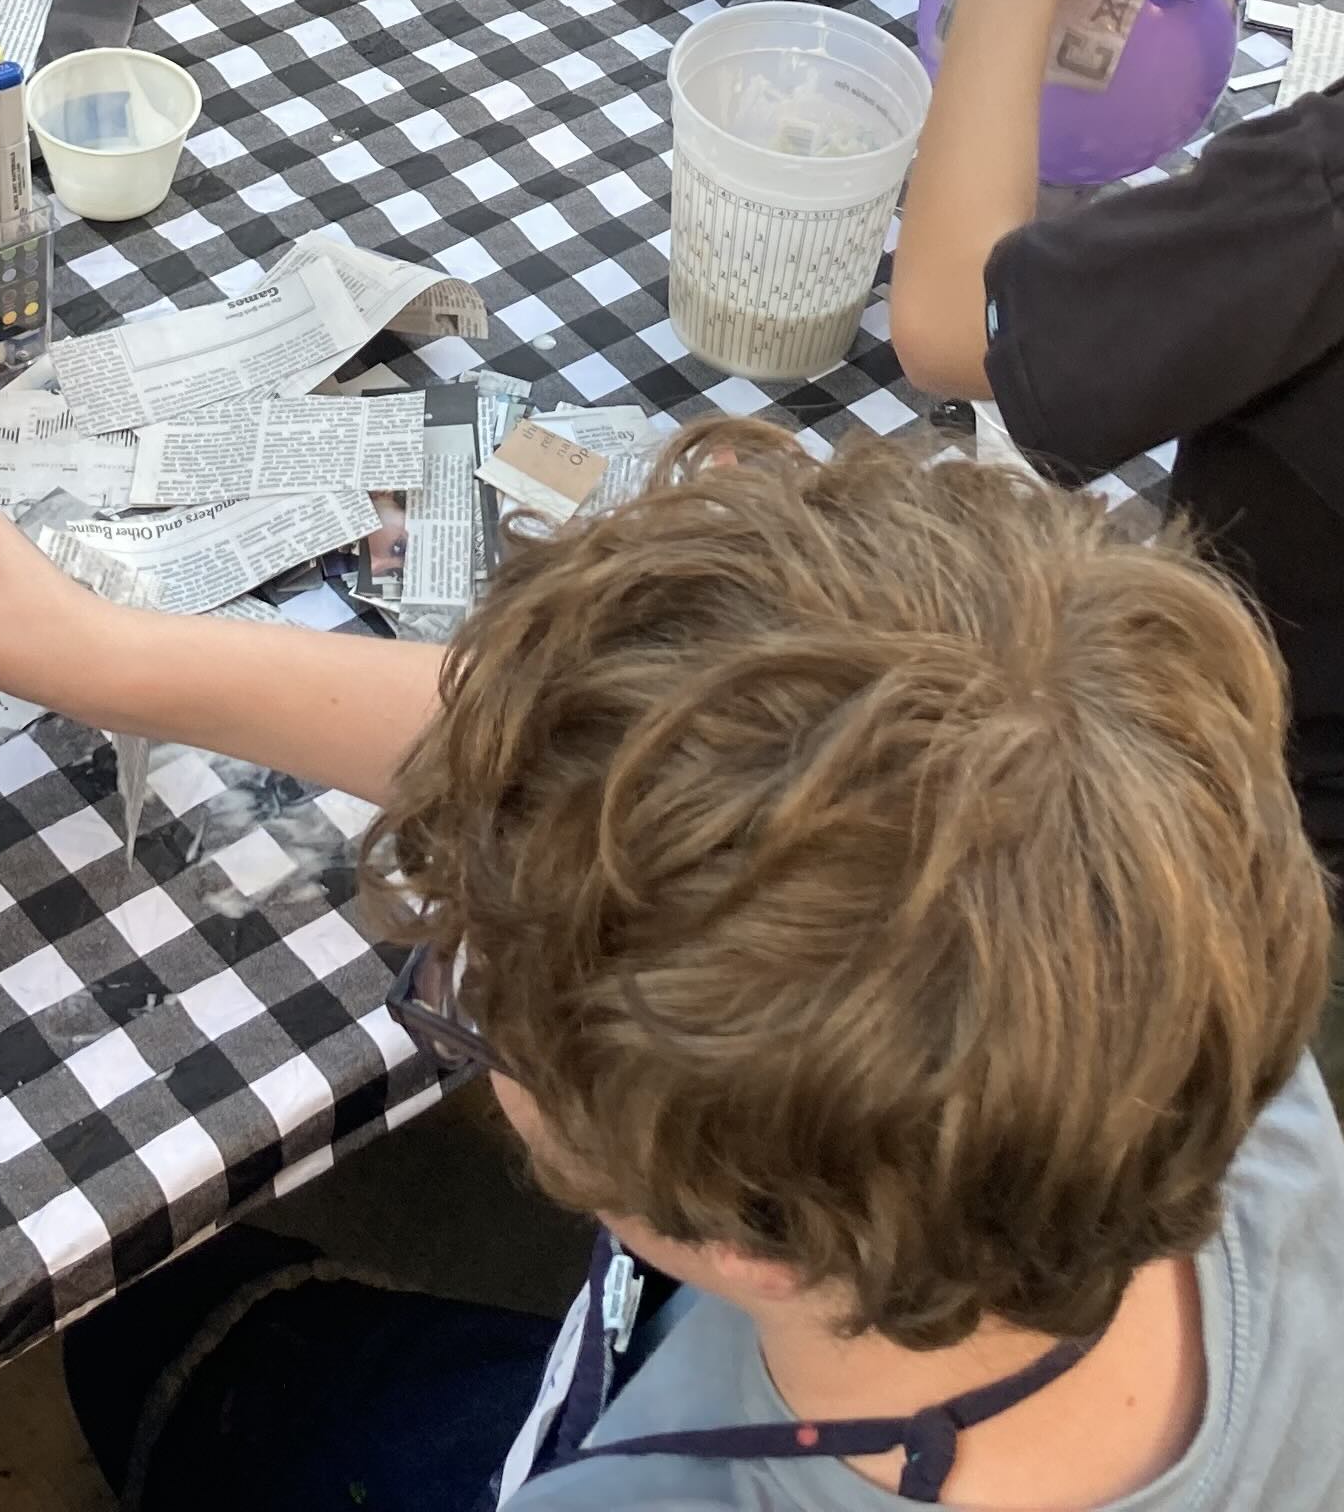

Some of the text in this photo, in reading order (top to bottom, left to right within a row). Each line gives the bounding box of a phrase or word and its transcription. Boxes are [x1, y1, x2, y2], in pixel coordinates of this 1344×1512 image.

[227, 286, 280, 309] Games
[116, 526, 153, 540] Other
[155, 519, 183, 534] and
